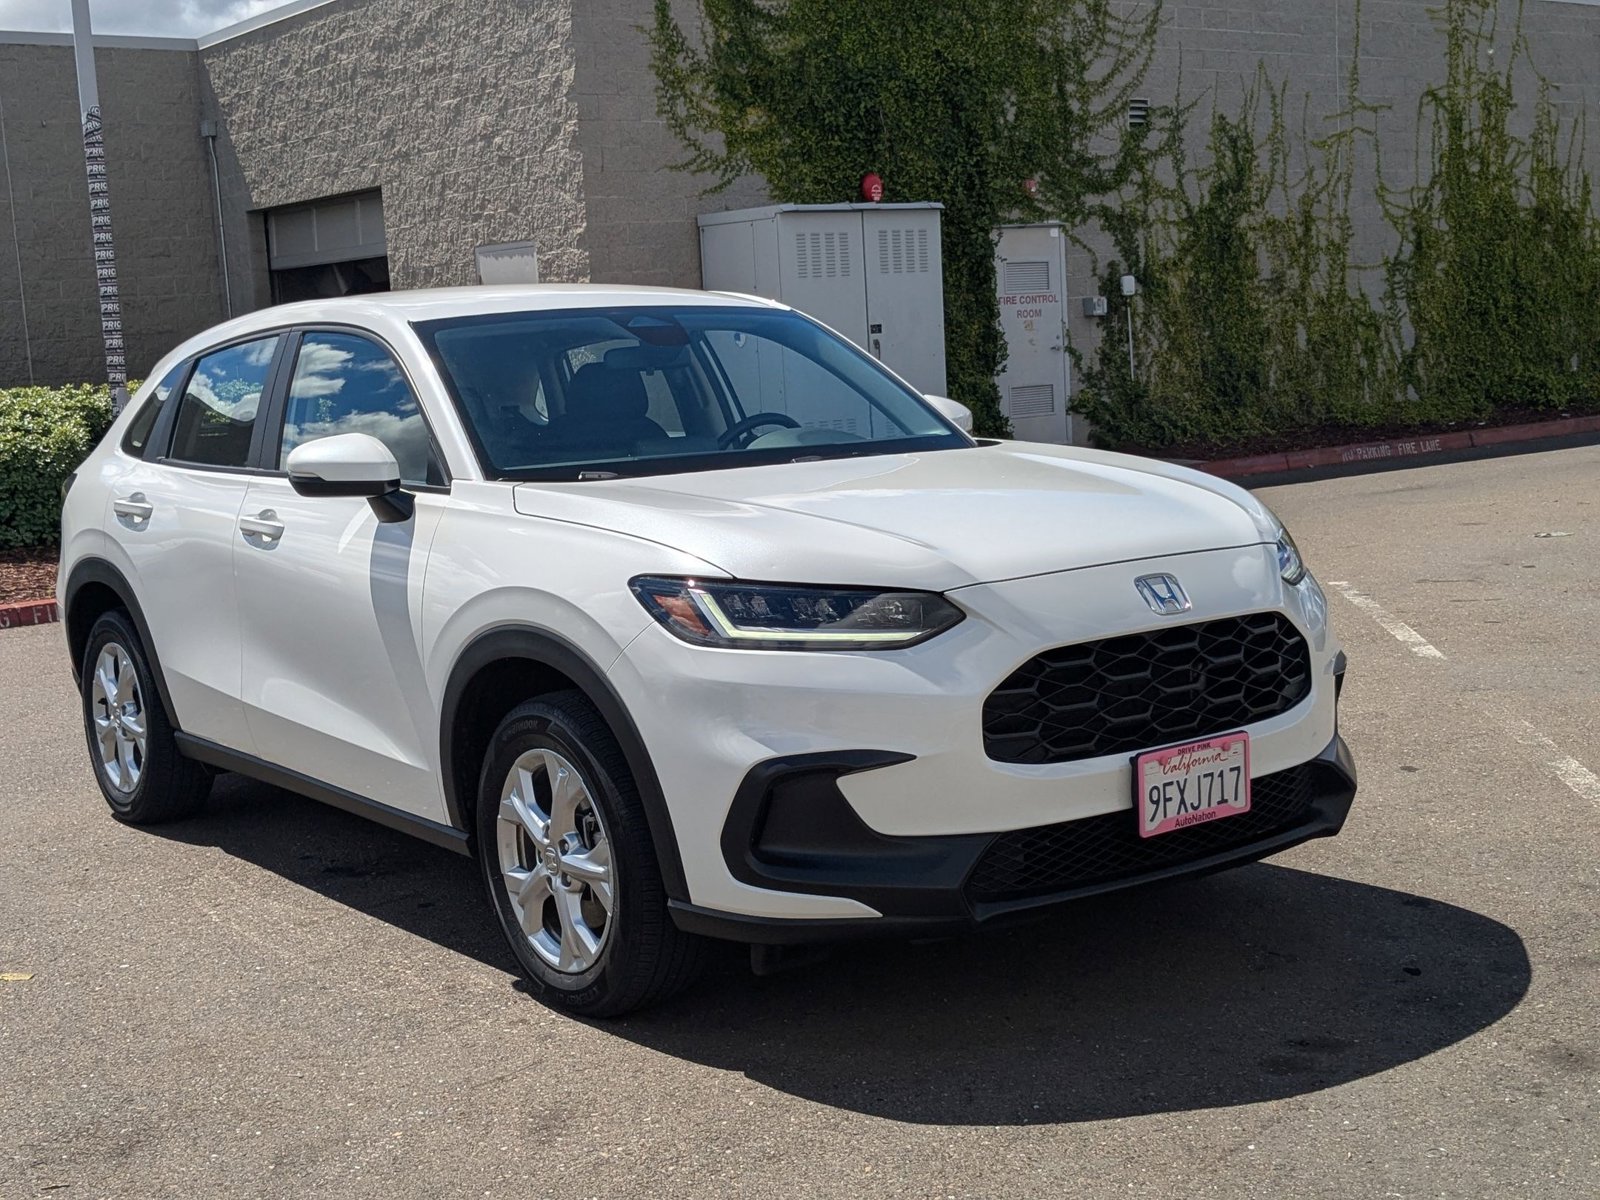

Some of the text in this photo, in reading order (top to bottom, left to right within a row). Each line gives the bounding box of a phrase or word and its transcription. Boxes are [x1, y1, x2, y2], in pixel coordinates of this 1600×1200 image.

[997, 294, 1058, 305] FIRE CONTROL
[1016, 309, 1042, 318] ROOM
[1397, 442, 1418, 456] FIRE
[1420, 439, 1442, 452] LANE
[1177, 742, 1211, 755] DRIVE PINK
[1162, 751, 1229, 775] California
[1148, 766, 1241, 822] 9FXJ717
[1174, 810, 1217, 828] AutoNation
